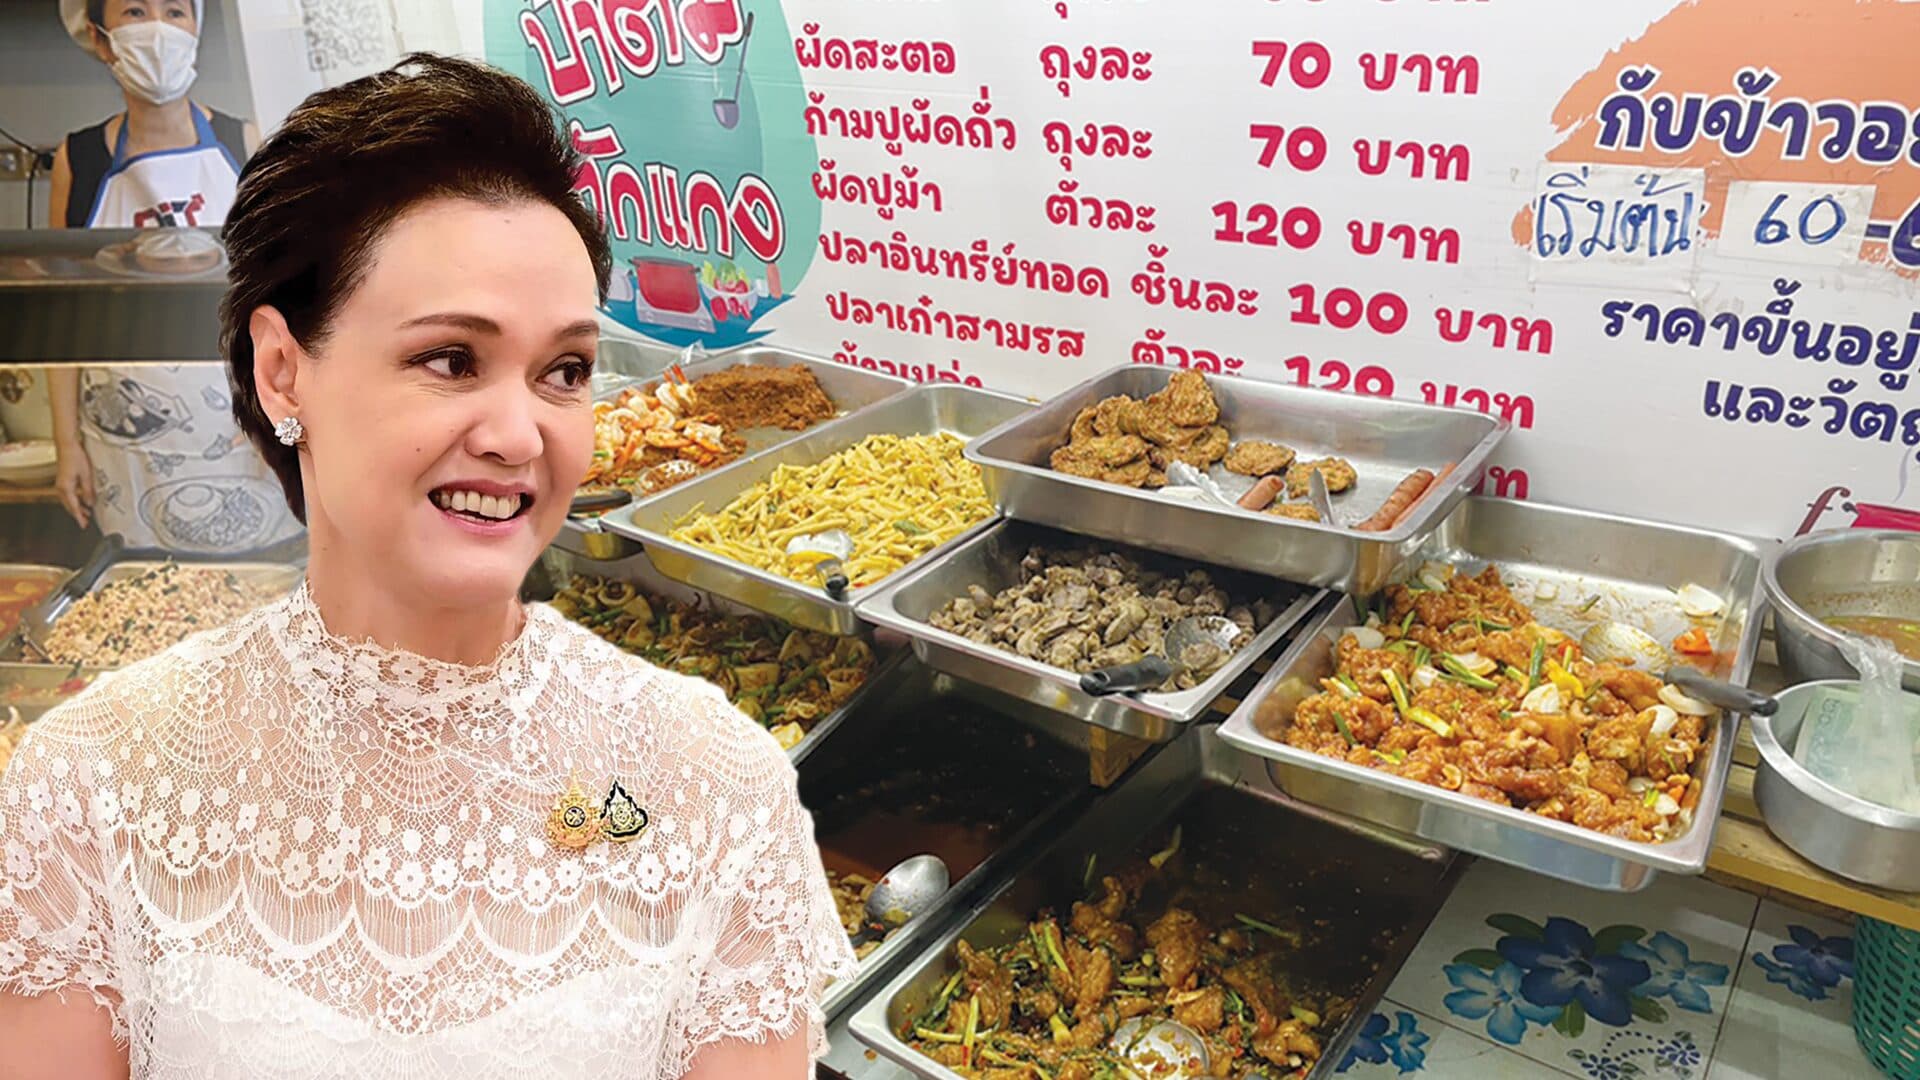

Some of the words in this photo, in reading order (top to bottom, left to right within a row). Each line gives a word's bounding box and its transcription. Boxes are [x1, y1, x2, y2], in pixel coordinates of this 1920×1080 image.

[795, 23, 956, 73] ผัดสะตอ
[1040, 45, 1152, 97] ถุงละ
[1252, 41, 1331, 88] 70
[1359, 53, 1479, 94] บาท
[804, 86, 1016, 156] ก้ามปูผัดถั่ว
[1043, 121, 1152, 171] ถุงละ
[1250, 124, 1327, 171] 70
[1353, 139, 1470, 181] บาท
[1600, 70, 1920, 162] กับข้าวอ
[811, 159, 942, 220] ผัดปูม้า
[1046, 180, 1156, 232] ตัวละ
[1212, 201, 1322, 249] 120
[1347, 220, 1460, 263] บาท
[1535, 165, 1692, 258] เริ่มต้น
[1755, 194, 1847, 245] 60
[818, 231, 1110, 299] ปลาอินทรีย์ทอด
[1131, 244, 1258, 315] ชิ้นละ
[1288, 284, 1408, 334] 100
[1435, 307, 1553, 354] บาท
[825, 291, 1086, 358] ปลาเก๋าสามรส
